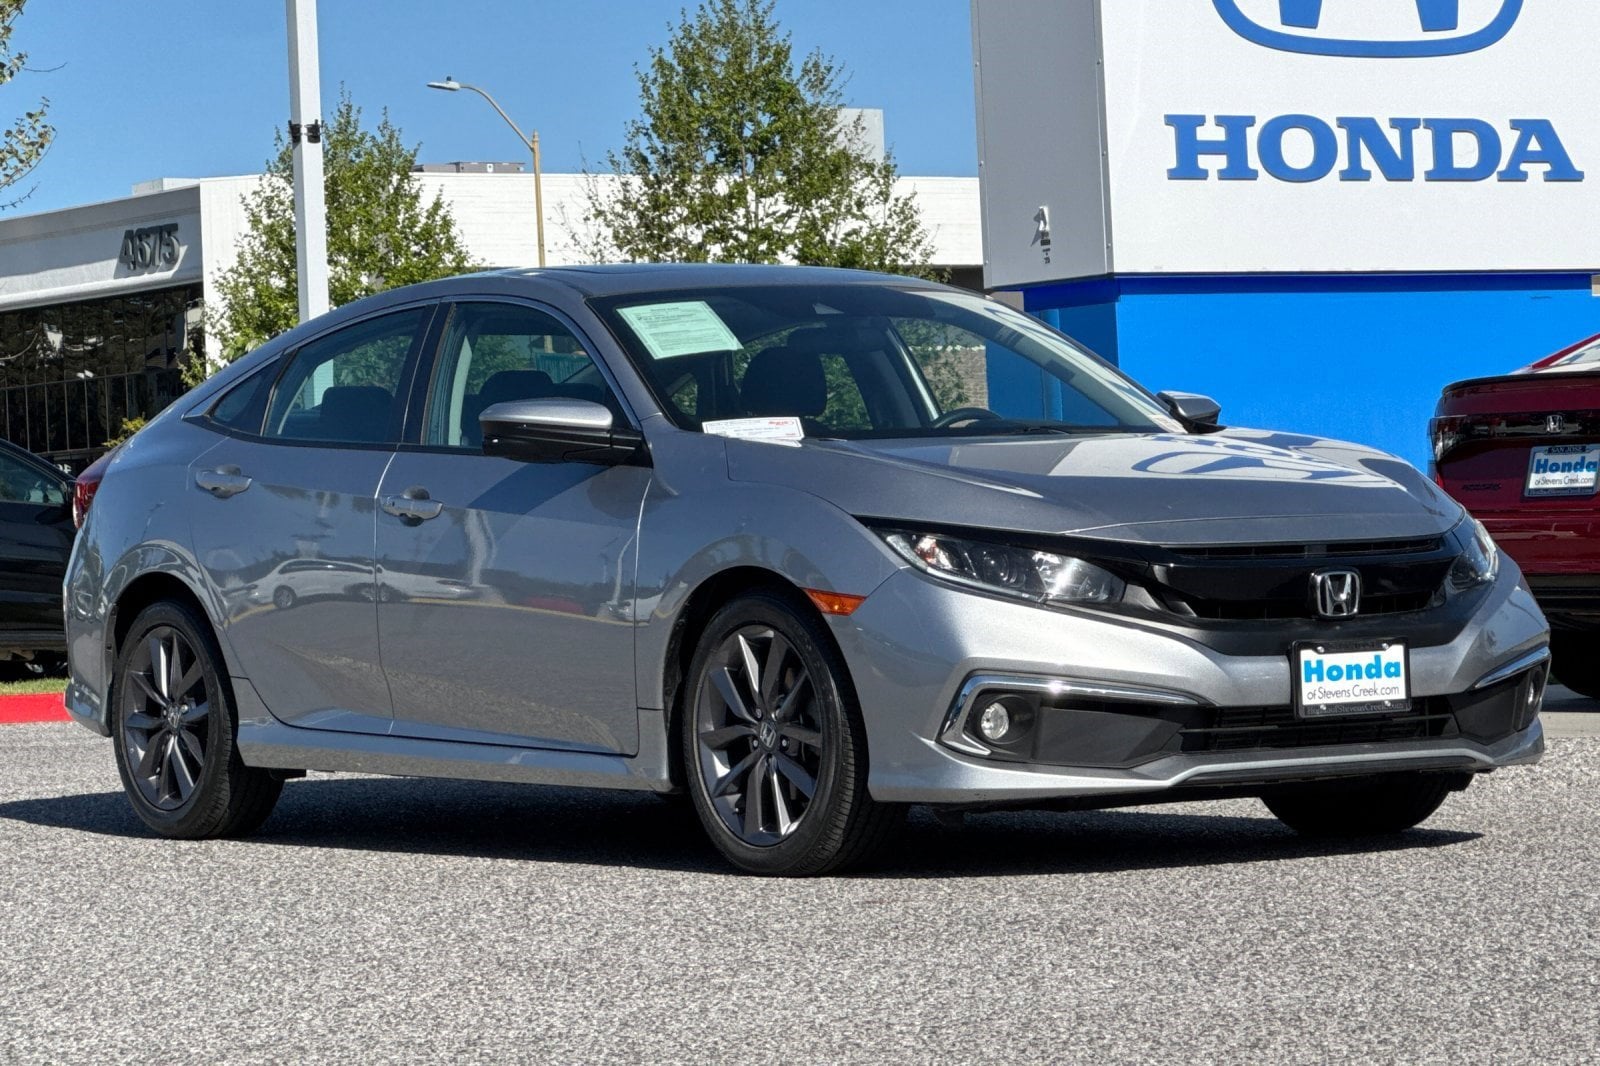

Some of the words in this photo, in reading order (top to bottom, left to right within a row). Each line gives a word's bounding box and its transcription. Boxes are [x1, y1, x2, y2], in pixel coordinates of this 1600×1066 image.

[1164, 114, 1585, 183] HONDA
[119, 222, 180, 271] 4675
[1535, 456, 1598, 474] Honda
[1541, 476, 1563, 486] Stevens
[1563, 475, 1594, 485] Creek.com
[1304, 655, 1401, 682] Honda
[1307, 690, 1317, 701] of
[1317, 686, 1351, 700] Stevens
[1352, 681, 1400, 698] Creek.com
